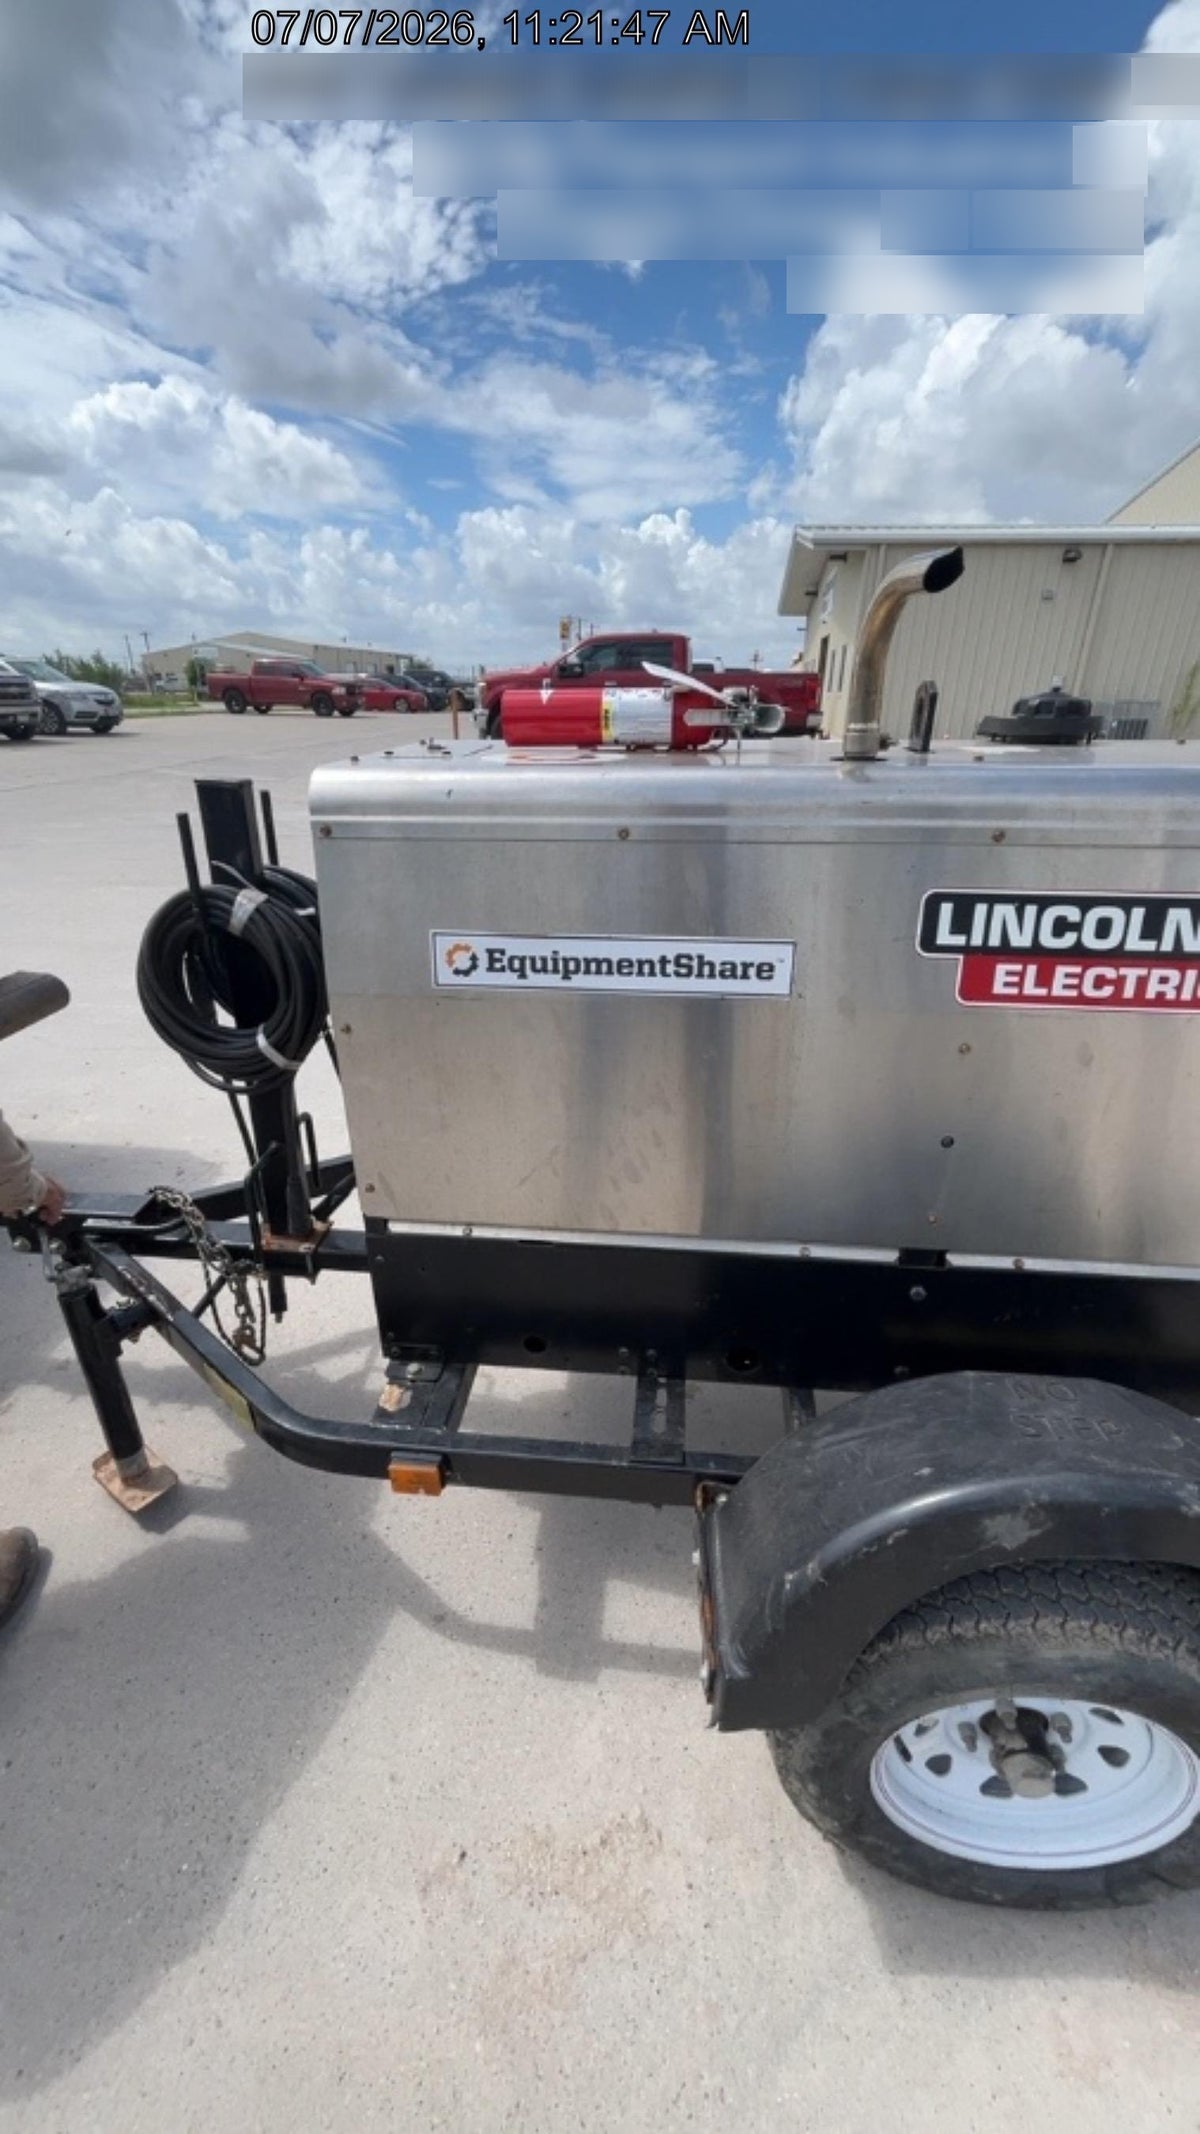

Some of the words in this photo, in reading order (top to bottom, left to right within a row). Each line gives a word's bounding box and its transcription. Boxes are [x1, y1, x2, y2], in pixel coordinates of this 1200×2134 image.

[935, 902, 1200, 952] LINCOLN
[991, 963, 1200, 1001] ELECTRI
[1004, 1377, 1080, 1402] NO
[1008, 1411, 1123, 1441] STEP
